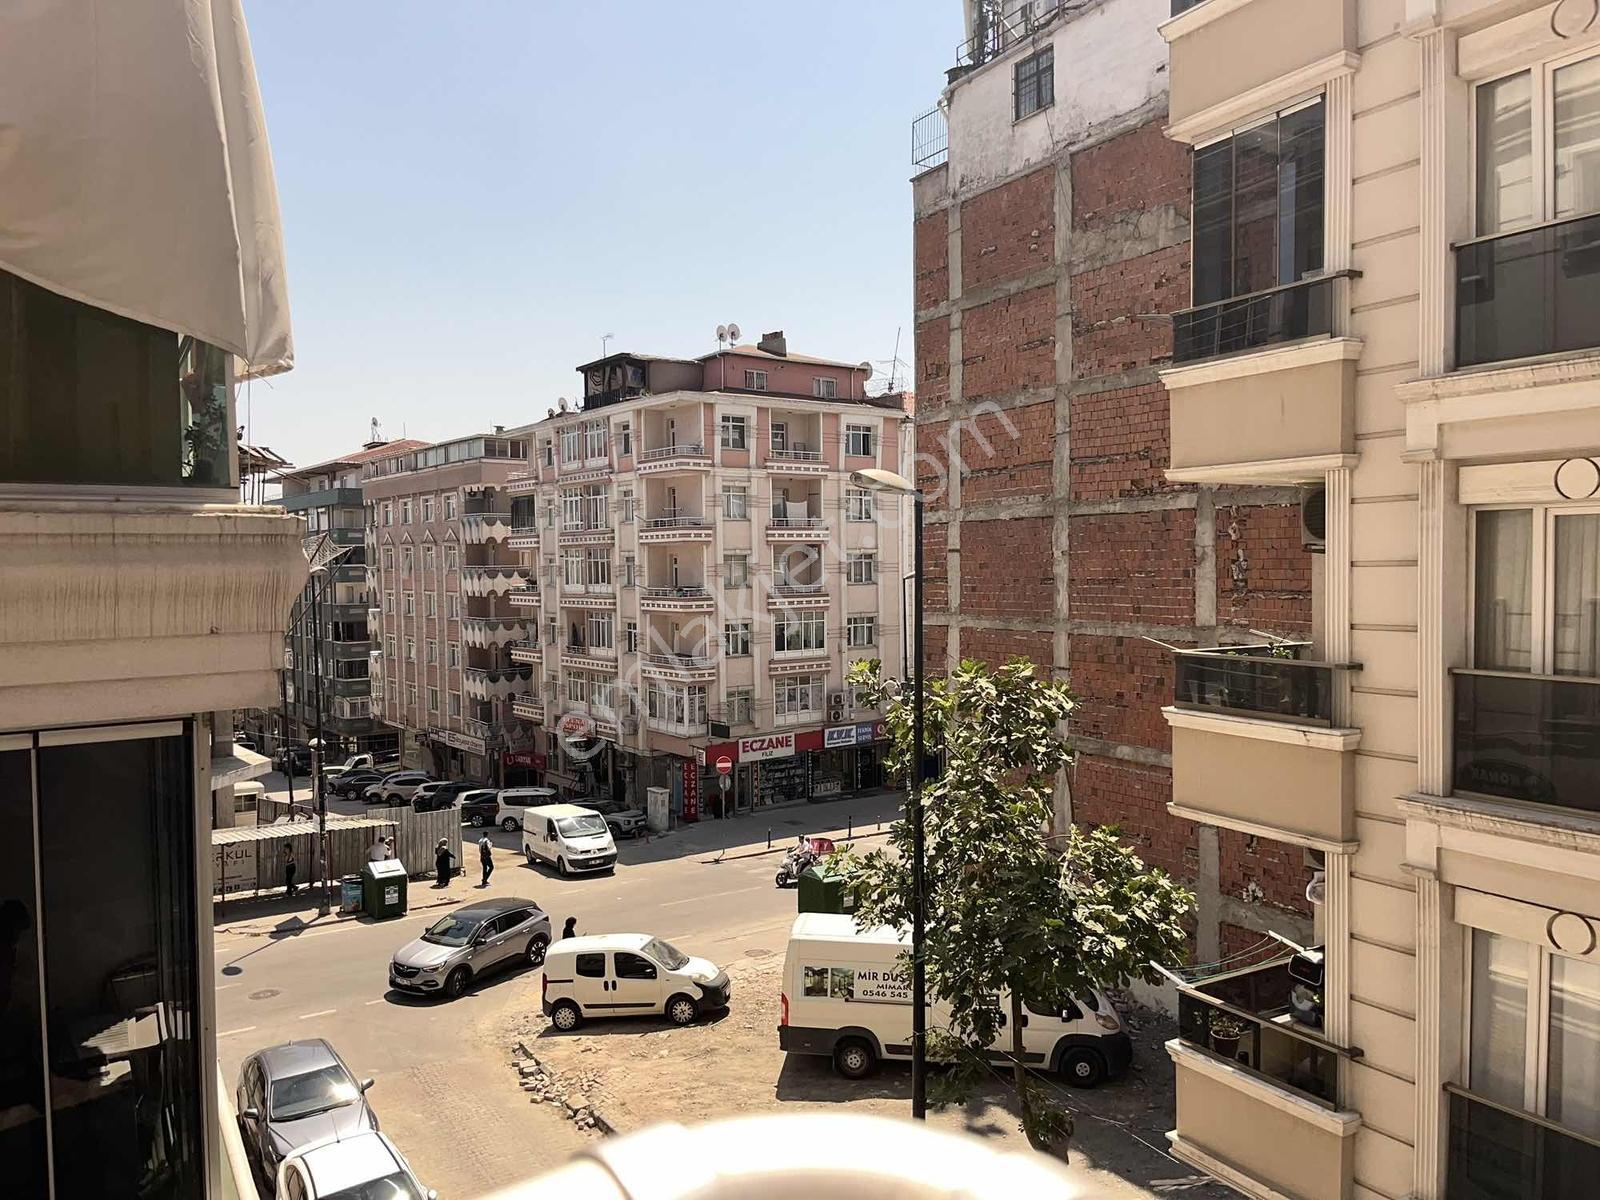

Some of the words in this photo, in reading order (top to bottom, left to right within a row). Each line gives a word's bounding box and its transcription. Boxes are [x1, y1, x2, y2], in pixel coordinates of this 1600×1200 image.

[742, 735, 792, 753] ECZANE
[212, 849, 253, 862] RKUL
[858, 969, 879, 981] MİR
[862, 989, 887, 998] 0546
[890, 991, 908, 999] 545
